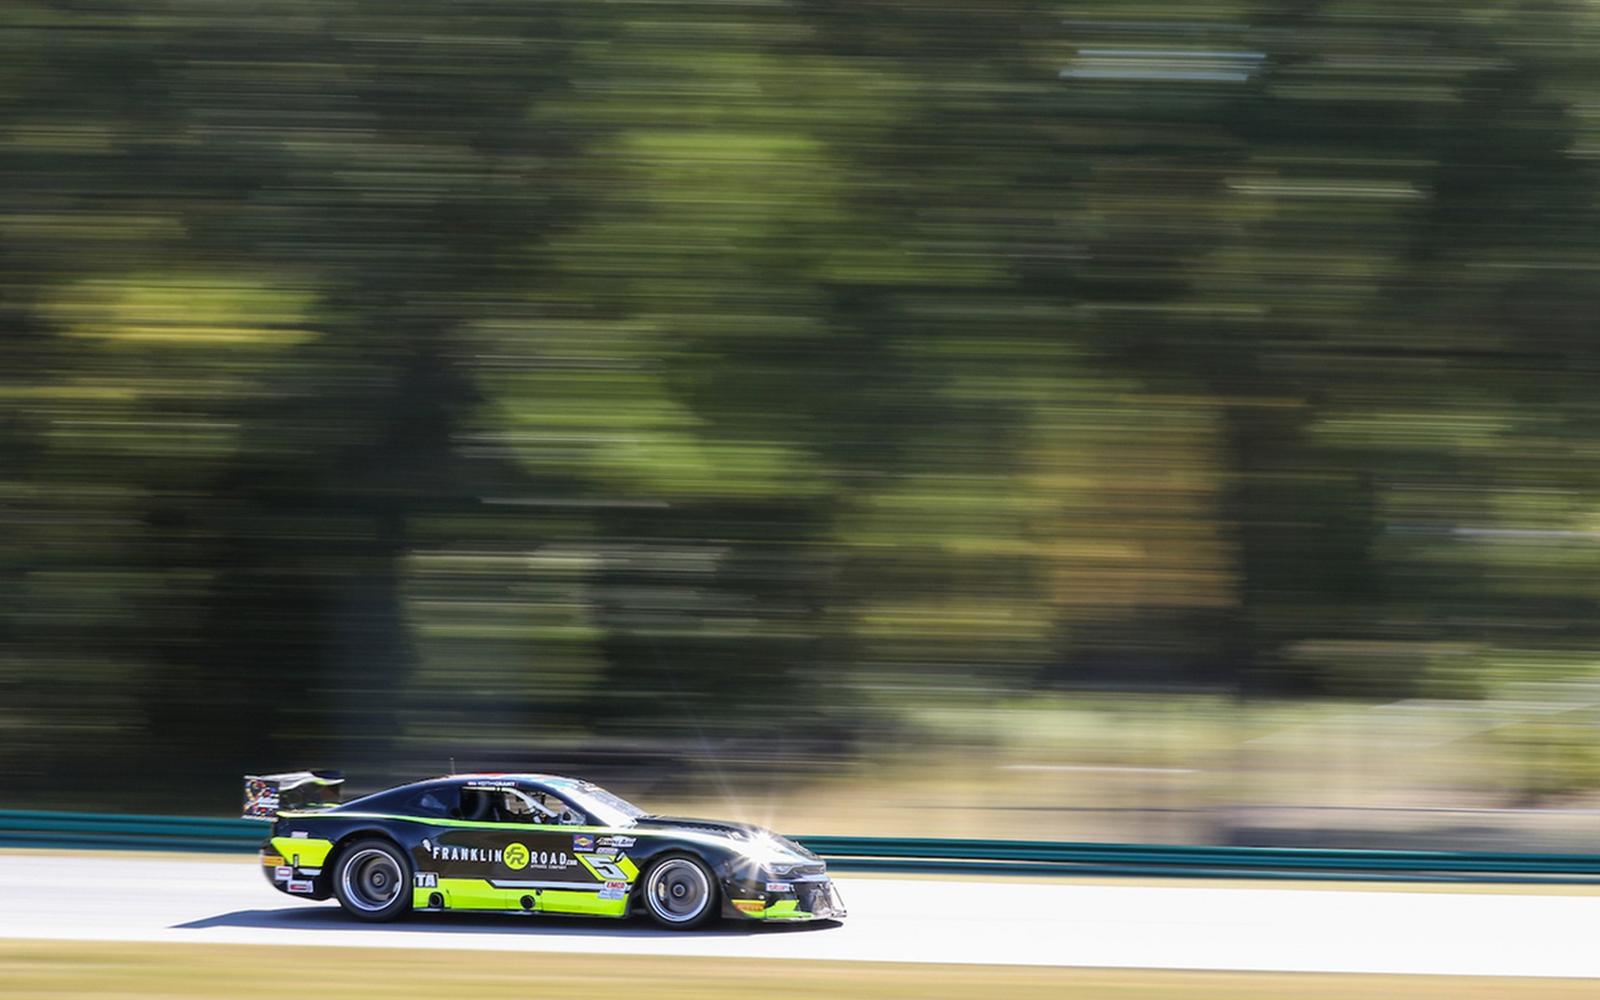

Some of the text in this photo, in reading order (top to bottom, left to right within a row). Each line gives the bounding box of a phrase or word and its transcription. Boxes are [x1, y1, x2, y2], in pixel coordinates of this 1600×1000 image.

[433, 847, 502, 862] FRANKLIN
[582, 855, 629, 880] 5
[416, 874, 437, 887] TA
